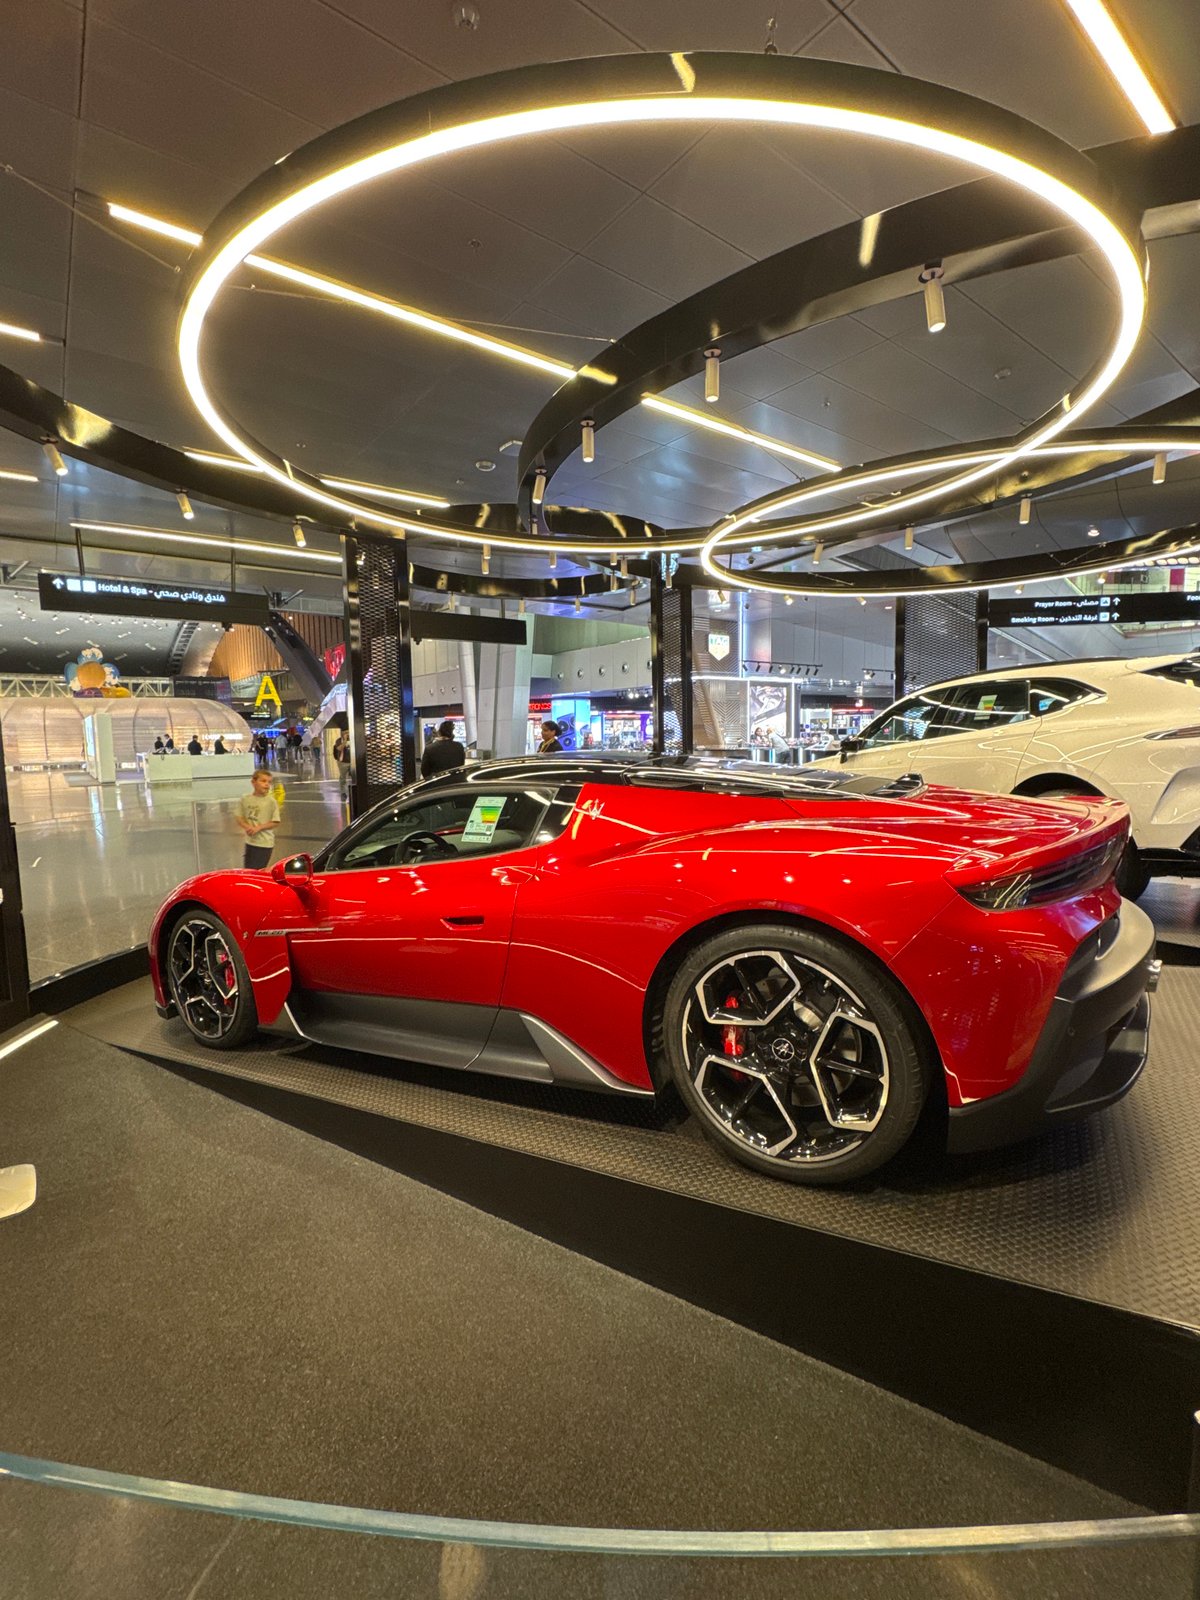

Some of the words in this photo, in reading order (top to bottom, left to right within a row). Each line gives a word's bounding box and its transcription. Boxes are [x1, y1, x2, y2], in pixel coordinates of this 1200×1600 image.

[98, 583, 121, 593] Hotel
[130, 586, 147, 596] Spa
[1011, 616, 1037, 624] Smoking
[255, 675, 283, 706] A
